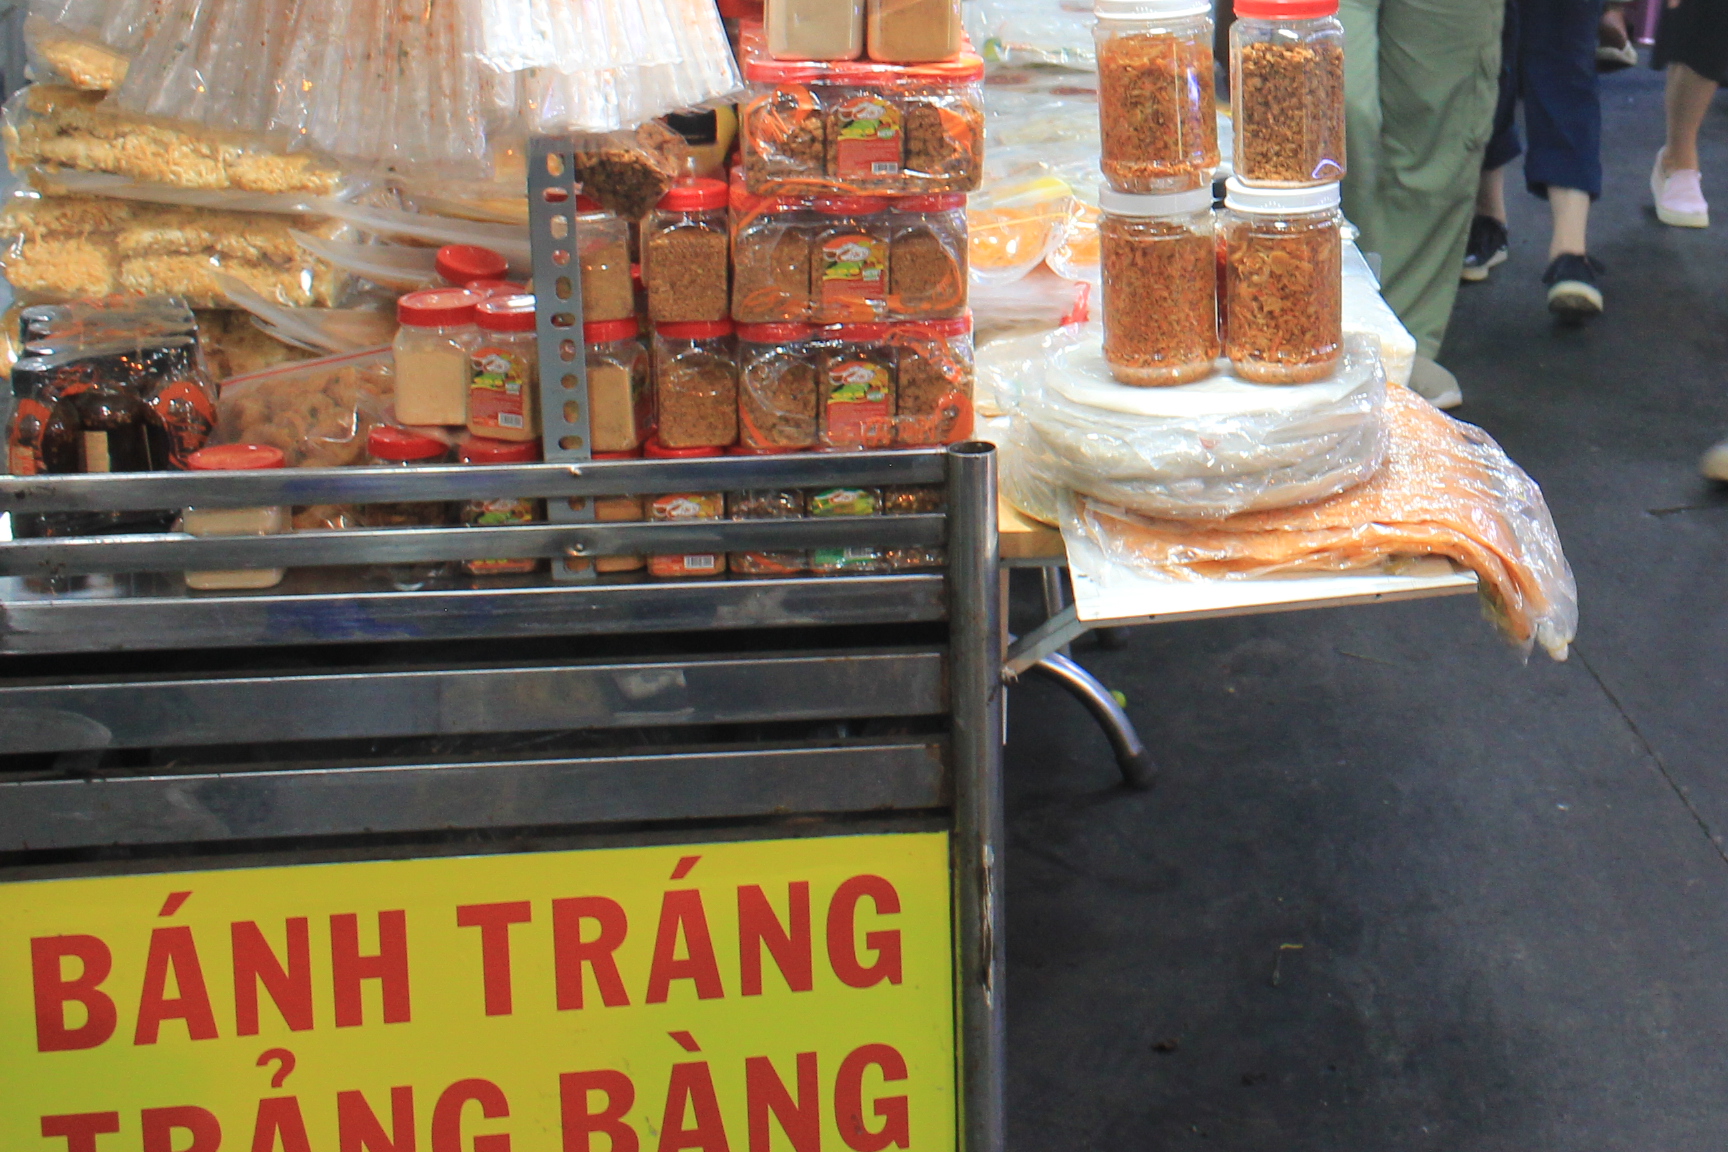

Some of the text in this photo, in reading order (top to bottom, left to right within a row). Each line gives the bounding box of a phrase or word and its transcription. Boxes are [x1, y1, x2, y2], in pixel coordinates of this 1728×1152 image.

[31, 855, 904, 1054] BÁNH TRÁNG
[559, 1030, 911, 1152] BÀNG
